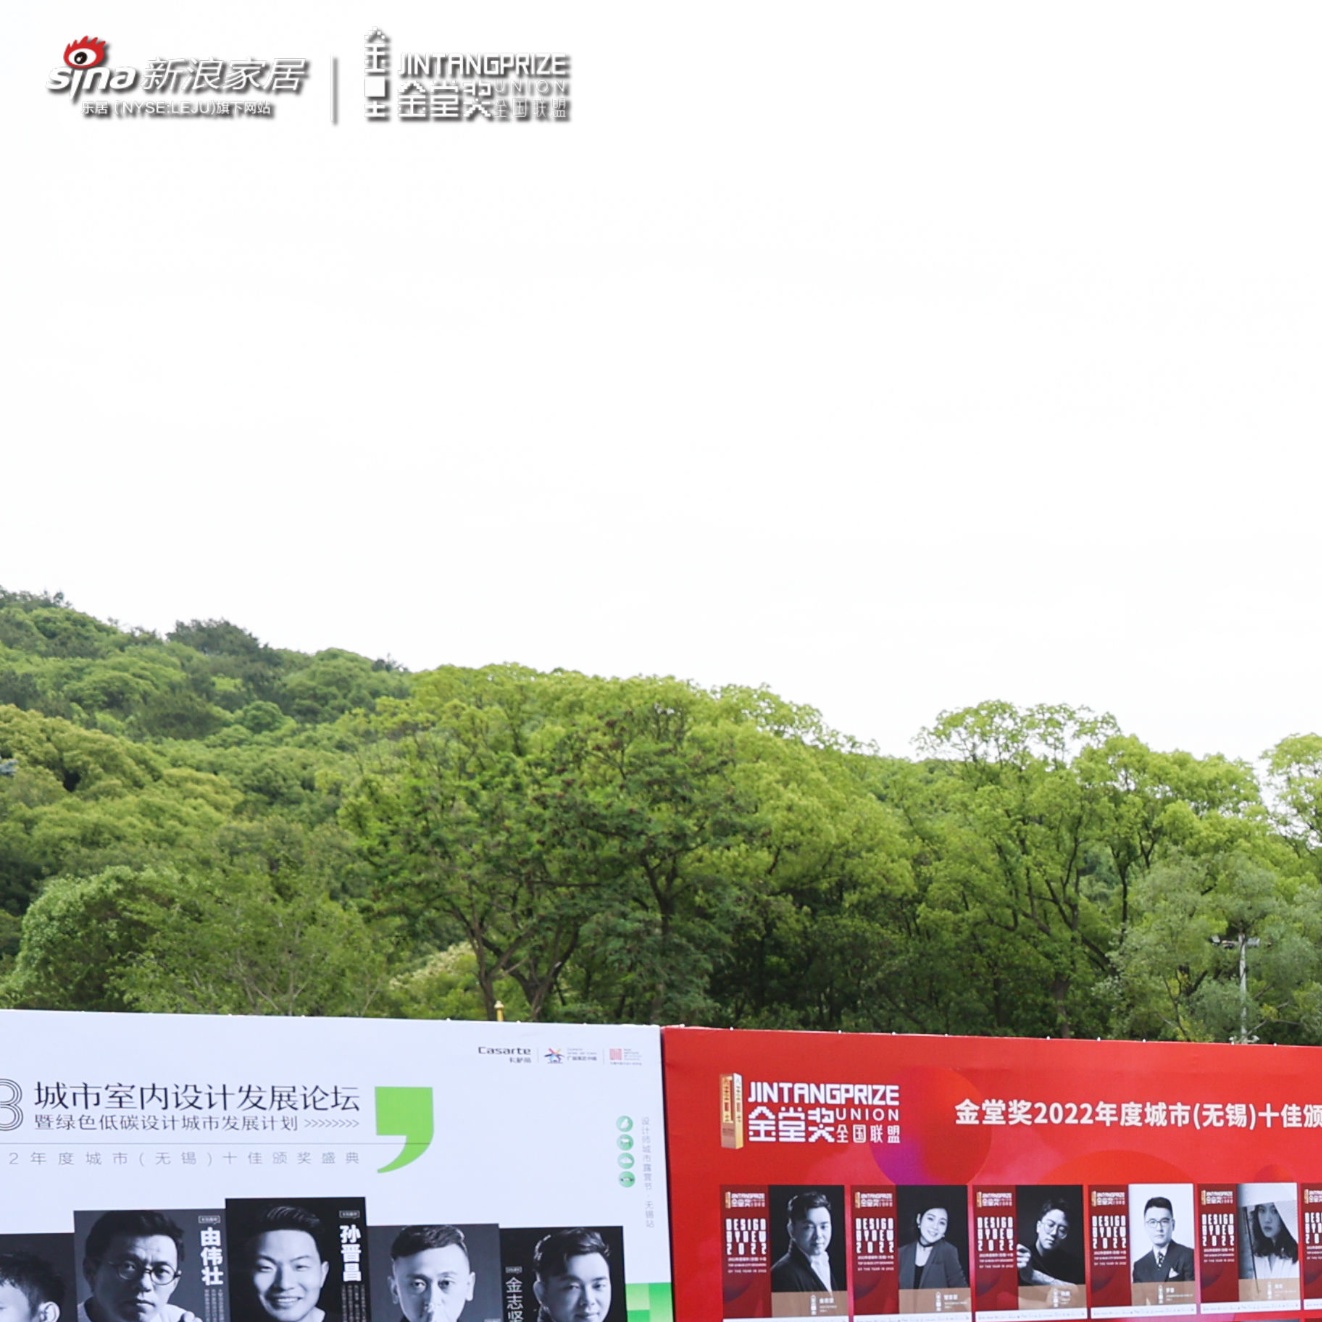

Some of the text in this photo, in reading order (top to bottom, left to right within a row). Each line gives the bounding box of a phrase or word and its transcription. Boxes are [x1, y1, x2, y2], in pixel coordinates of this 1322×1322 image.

[478, 1046, 531, 1055] Casarte
[34, 1081, 361, 1112] 城市室内设计发展论坛
[748, 1082, 899, 1105] JINTANGPRIZE
[35, 1114, 298, 1132] 暨绿色低碳设计城市发展计划
[748, 1106, 835, 1143] 金堂奖
[836, 1108, 899, 1121] UNION
[836, 1124, 900, 1143] 全国联盟
[200, 1227, 224, 1286] 由伟壮
[339, 1224, 362, 1282] 孙晋昌
